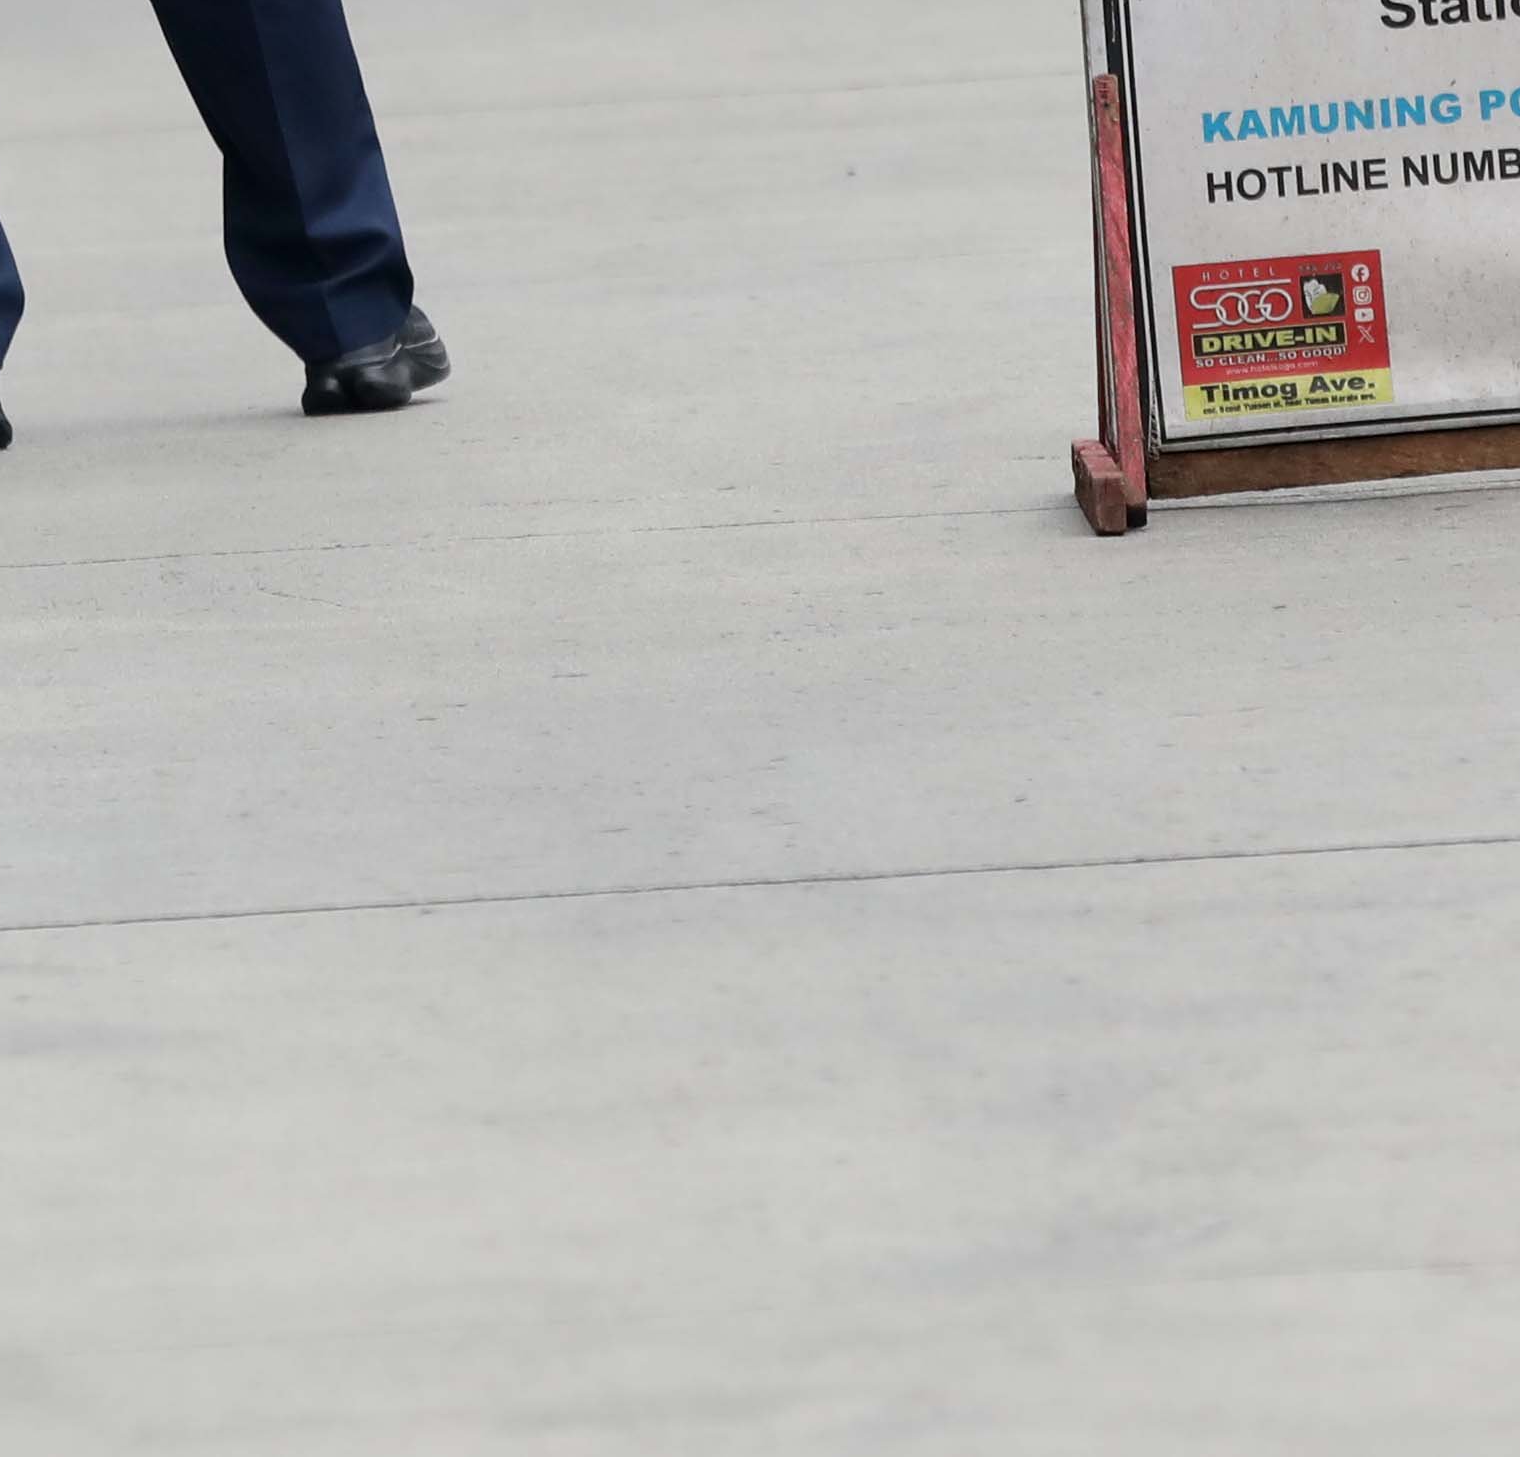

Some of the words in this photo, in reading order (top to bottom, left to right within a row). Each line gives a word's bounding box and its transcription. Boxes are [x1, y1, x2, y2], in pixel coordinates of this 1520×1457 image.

[1203, 94, 1461, 142] KAMUNING
[1207, 158, 1388, 203] HOTLINE
[1202, 266, 1277, 281] HOTEL
[1190, 278, 1293, 329] SOGO
[1201, 325, 1338, 353] DRIVE-IN
[1195, 357, 1215, 368] SO
[1302, 346, 1347, 359] GOOD!
[1200, 382, 1299, 404] Timog
[1308, 375, 1376, 394] Ave.
